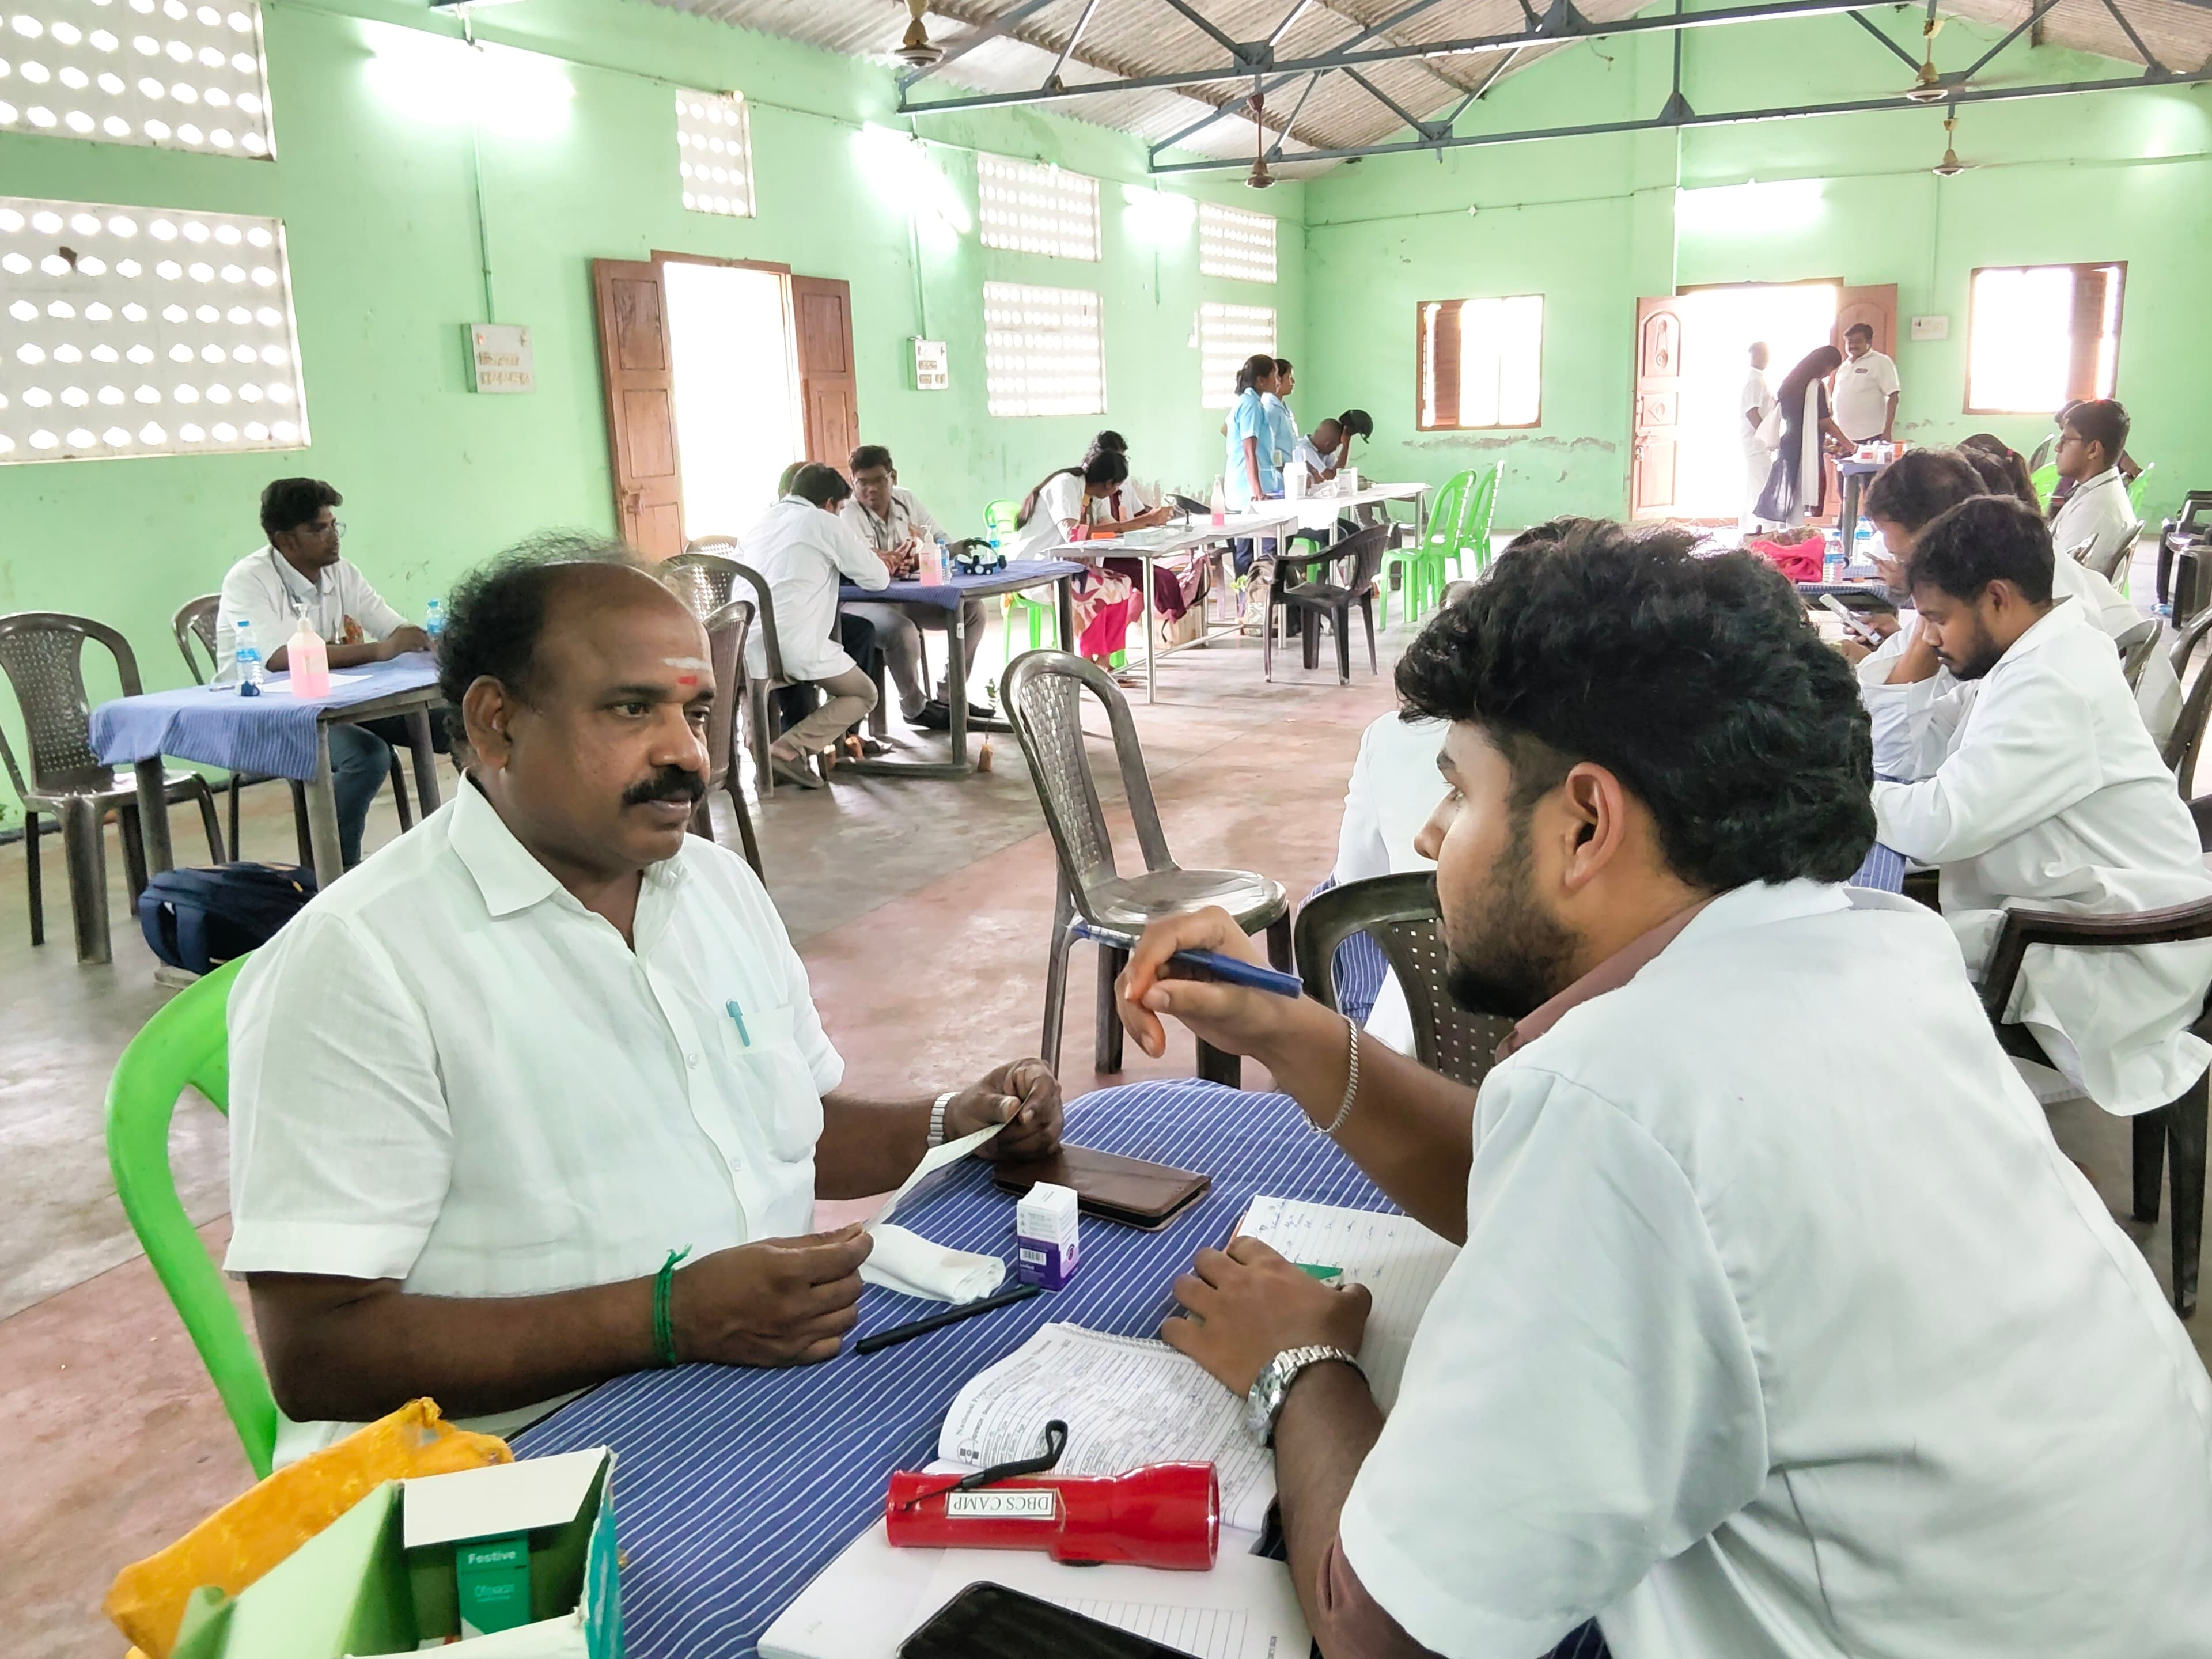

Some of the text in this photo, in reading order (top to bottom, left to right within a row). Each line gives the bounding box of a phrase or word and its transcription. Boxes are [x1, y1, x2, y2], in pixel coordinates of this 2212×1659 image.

[953, 1497, 1049, 1511] DBCS CAMP
[468, 1550, 516, 1565] Festive
